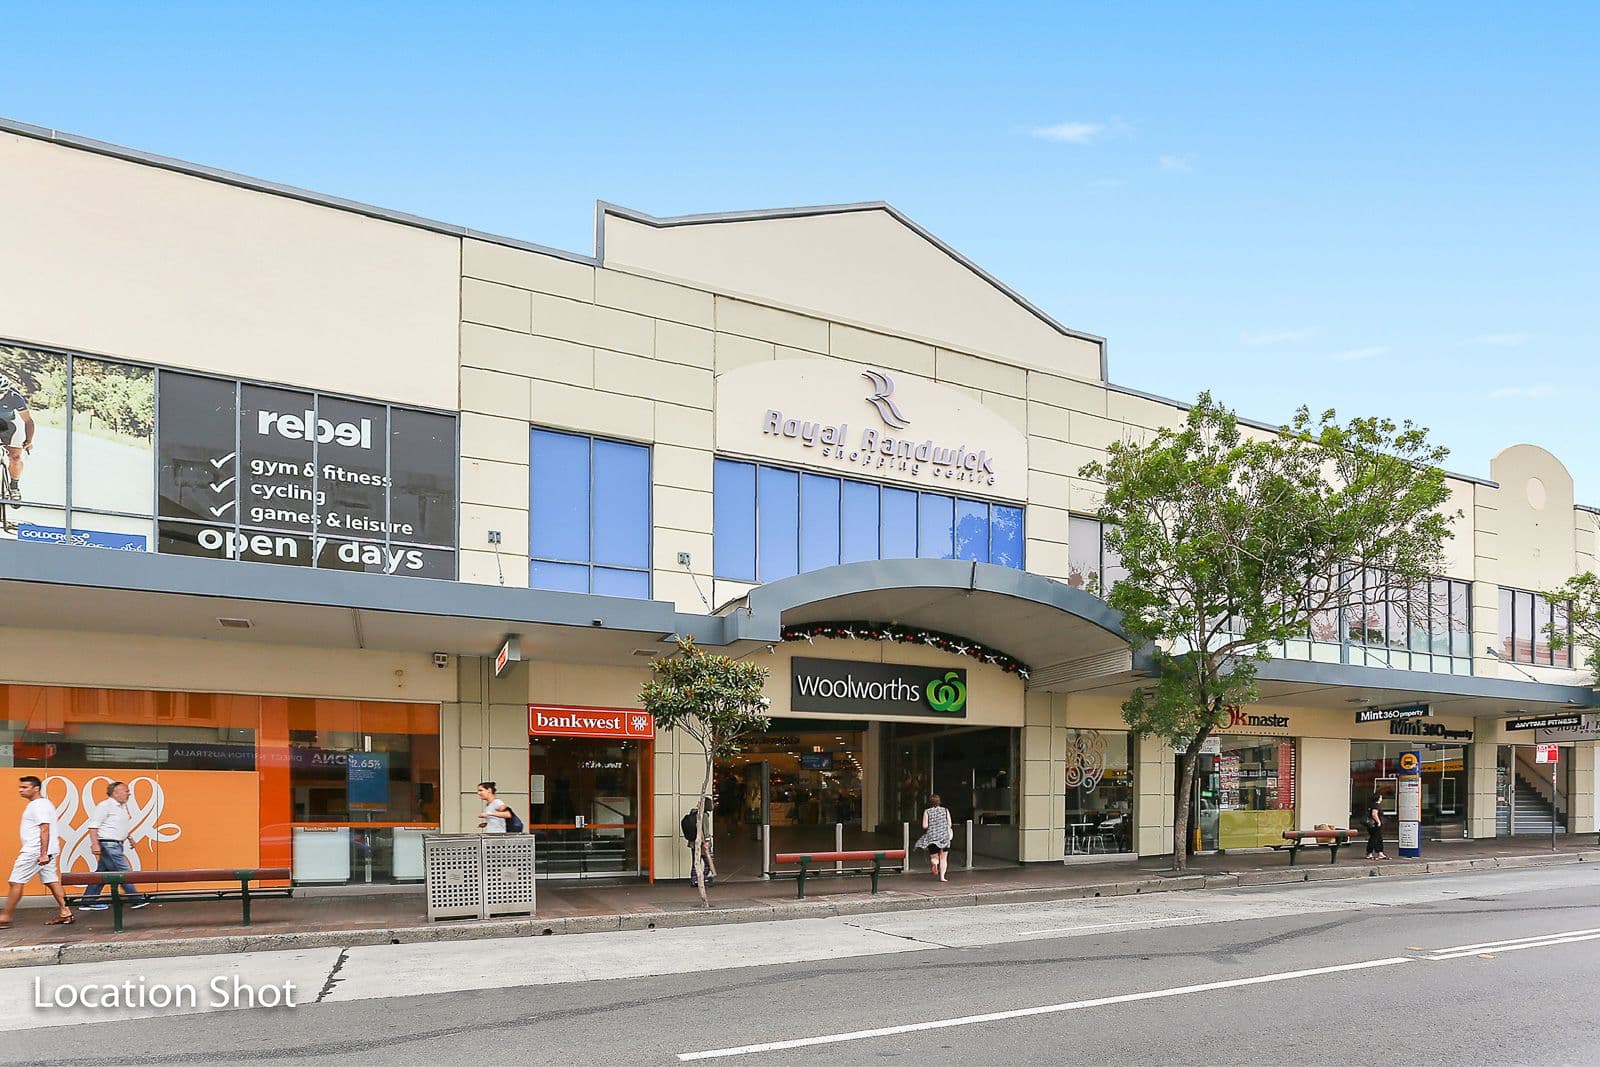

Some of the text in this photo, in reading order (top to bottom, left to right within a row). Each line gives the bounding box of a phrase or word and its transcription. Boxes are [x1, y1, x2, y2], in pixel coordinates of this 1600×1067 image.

[258, 409, 372, 449] rebel
[763, 408, 995, 474] Royal Randwick
[250, 459, 299, 477] gym
[322, 464, 393, 488] fitness
[822, 445, 997, 487] shopping centre
[250, 483, 326, 506] cycling
[250, 507, 413, 535] games & leisure
[197, 528, 298, 559] open
[337, 541, 425, 574] days
[797, 674, 920, 702] Woolworths
[536, 711, 621, 731] bankwest
[1515, 717, 1578, 729] ANYTIME FITNESS
